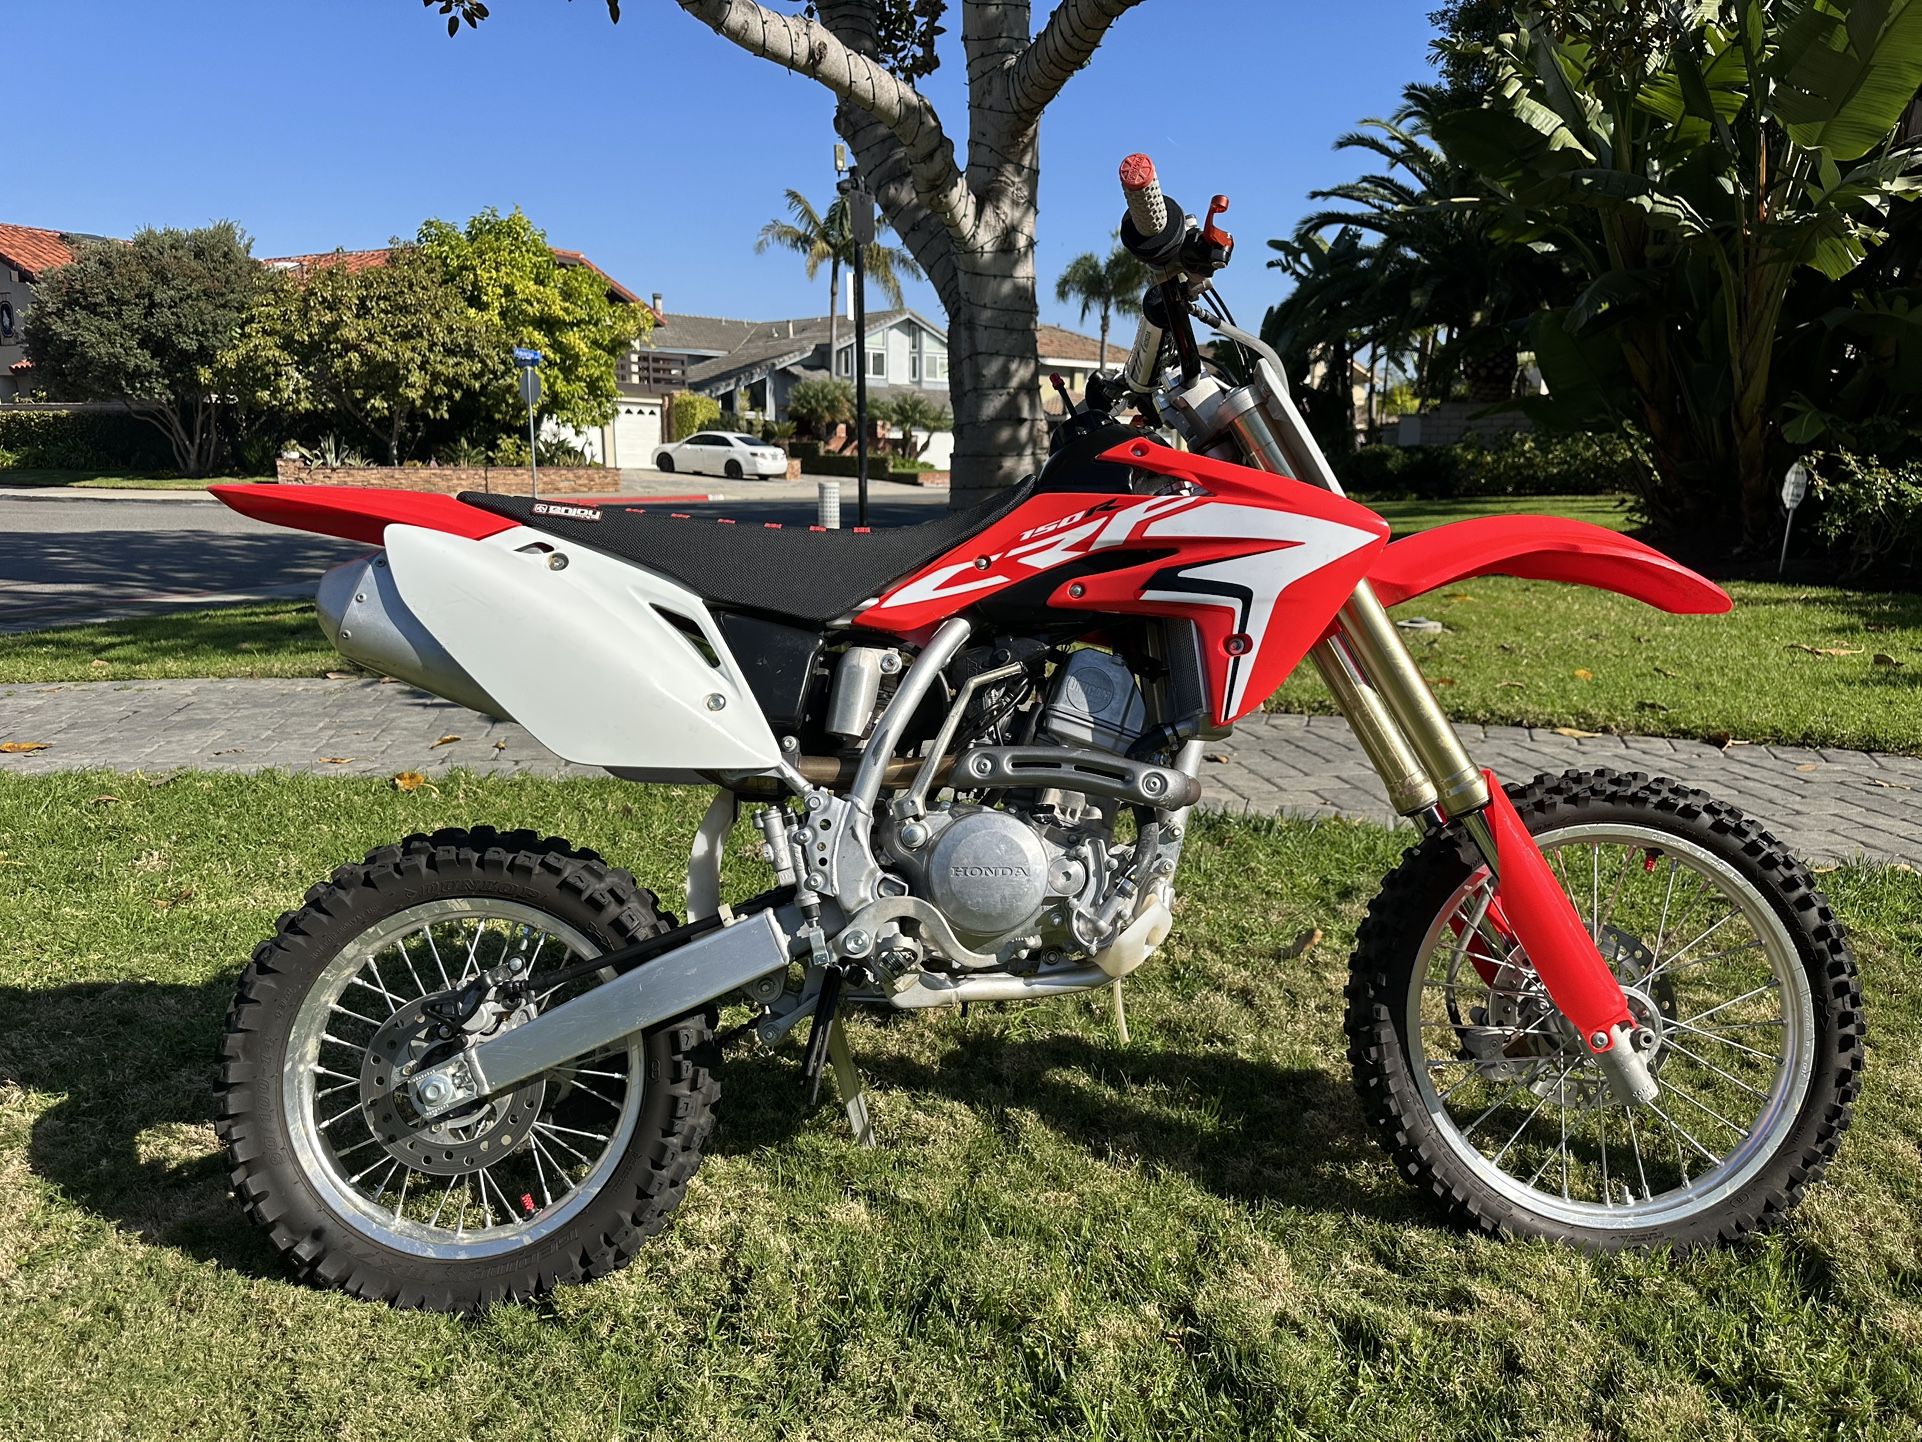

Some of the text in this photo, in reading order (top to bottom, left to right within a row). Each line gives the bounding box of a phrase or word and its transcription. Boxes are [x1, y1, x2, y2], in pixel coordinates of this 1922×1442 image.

[1019, 498, 1119, 541] 150R
[880, 495, 1200, 609] CRF
[951, 866, 1030, 878] HONDA
[416, 877, 540, 903] DUNLOP
